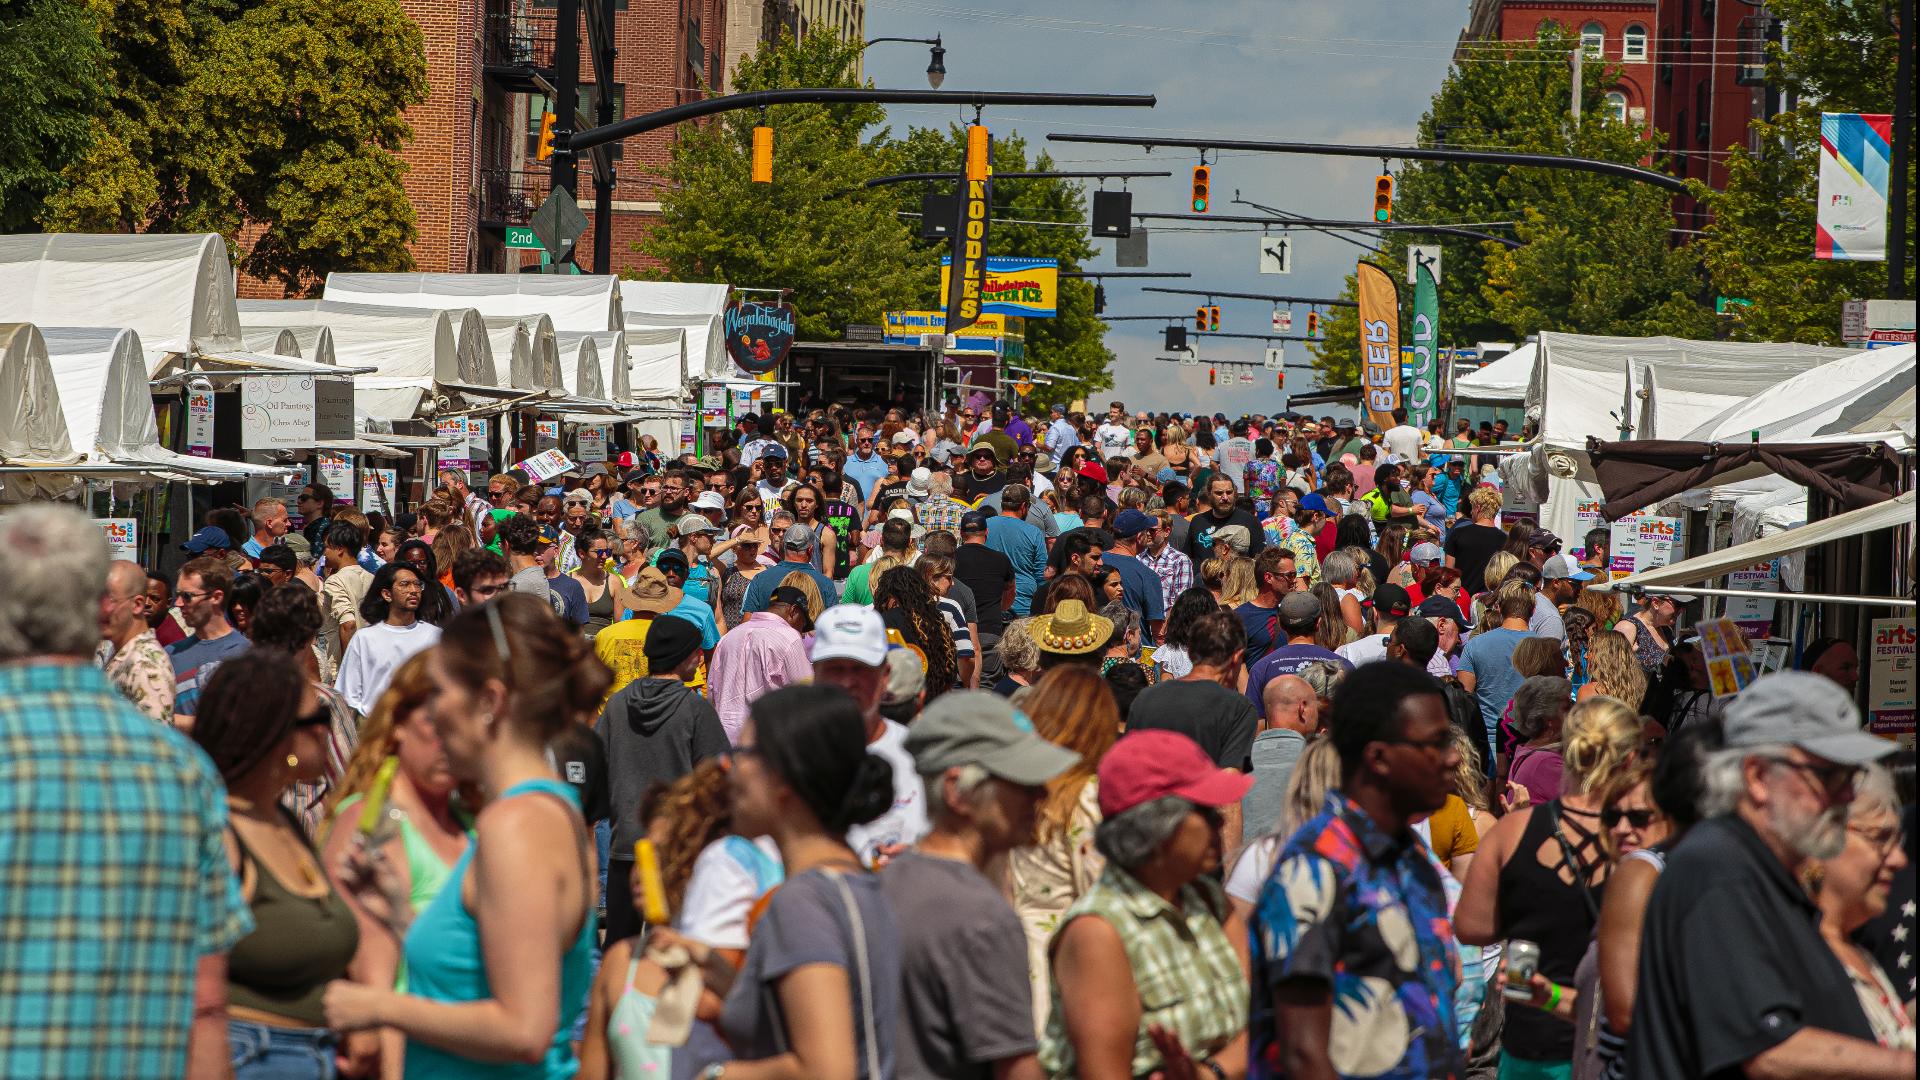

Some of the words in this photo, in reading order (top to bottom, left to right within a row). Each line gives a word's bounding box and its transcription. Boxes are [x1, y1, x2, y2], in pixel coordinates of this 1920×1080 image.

[511, 231, 533, 244] 2nd
[960, 181, 984, 318] NOODLES
[984, 280, 1040, 292] hiladelphia
[1022, 288, 1042, 302] ICE
[1874, 333, 1916, 342] INTERSTATE
[1364, 318, 1394, 412] BEER
[190, 394, 208, 407] arts
[281, 402, 314, 412] Paintings
[579, 427, 600, 437] arts
[1577, 501, 1600, 512] art
[1640, 520, 1674, 534] arts
[1640, 533, 1674, 541] FESTIVAL
[1734, 572, 1769, 580] FESTIVAL
[1875, 624, 1916, 645] arts
[1876, 646, 1915, 655] FESTIVAL
